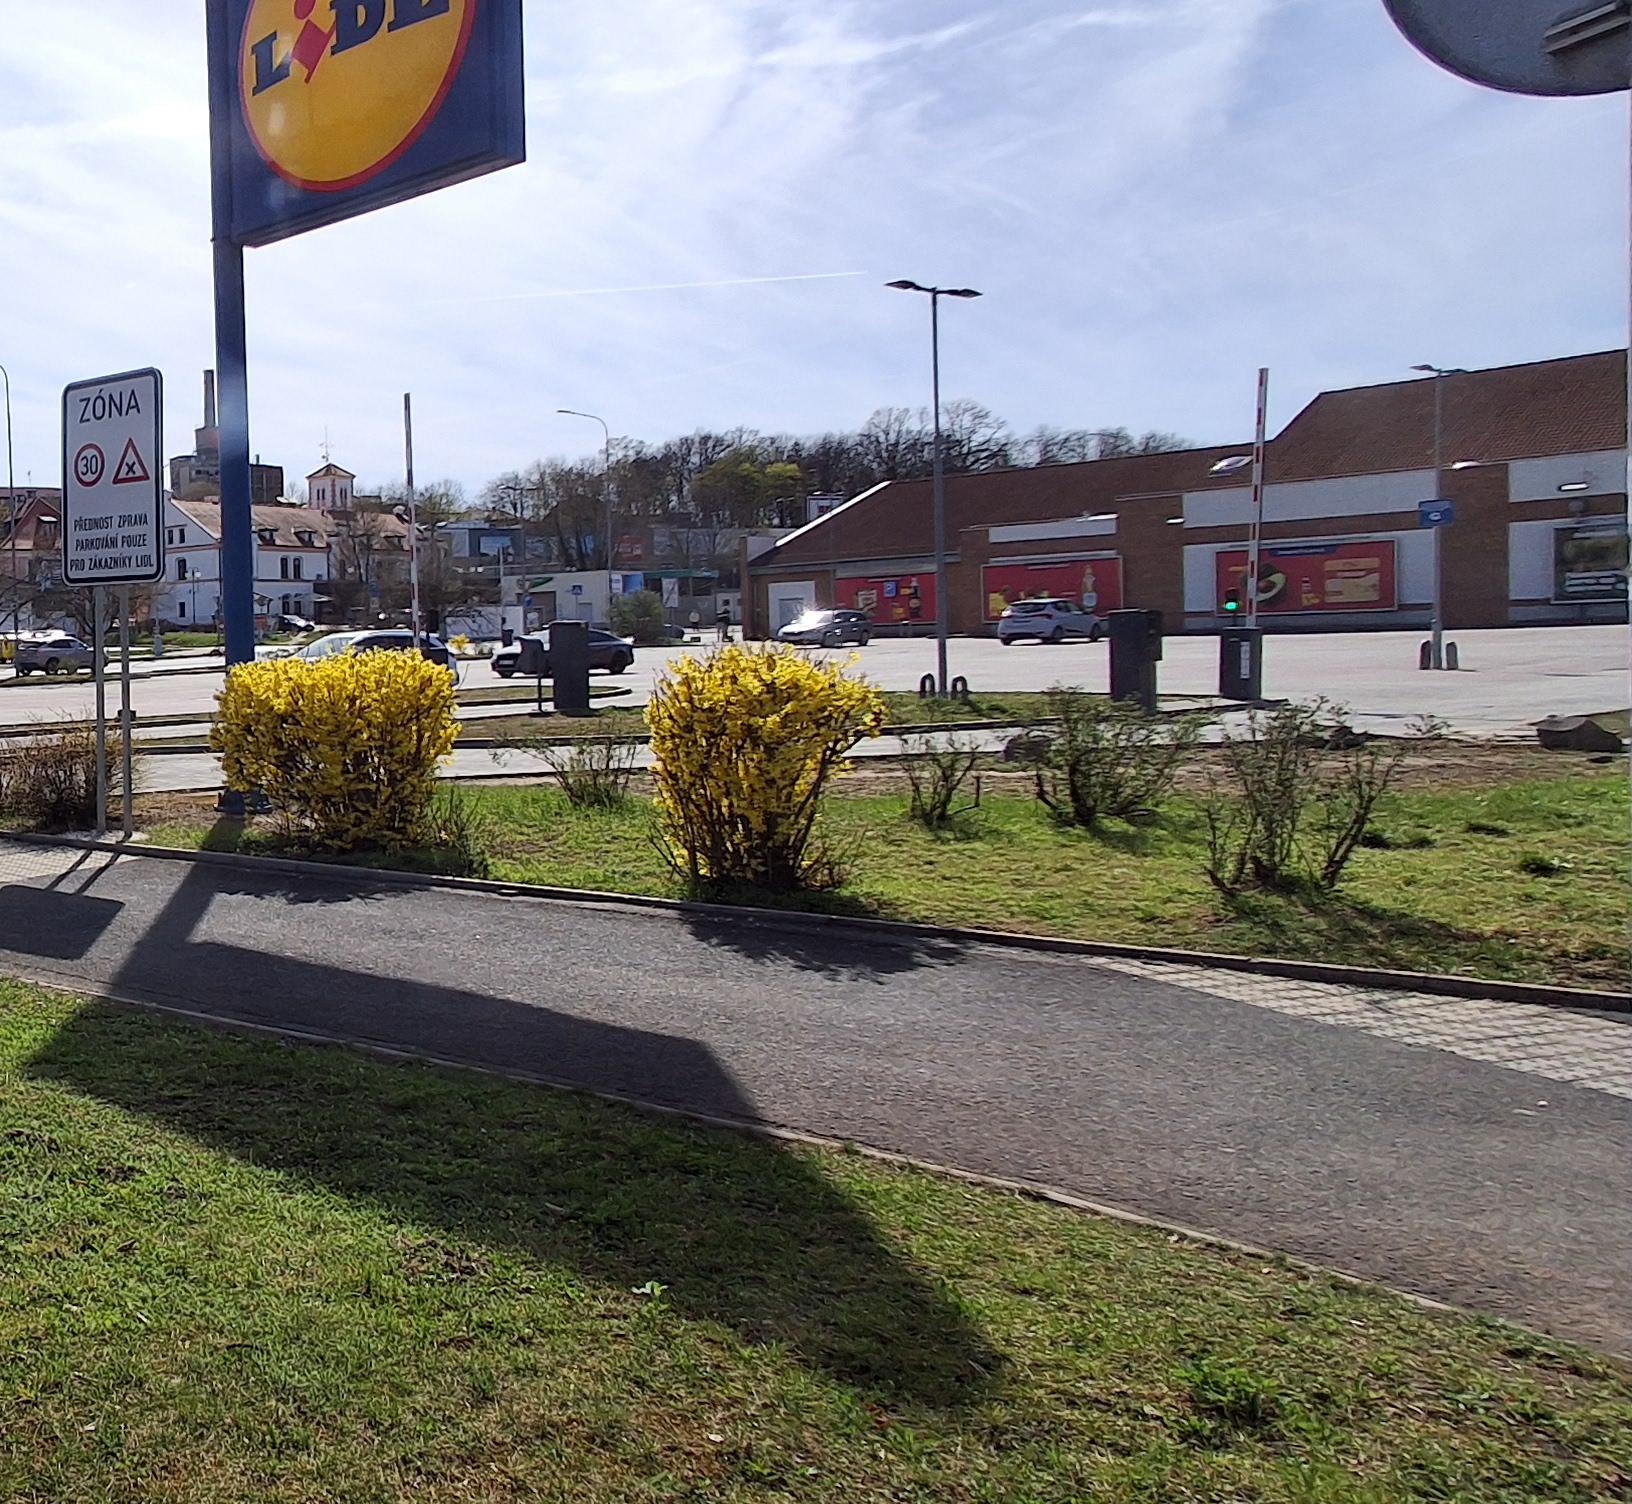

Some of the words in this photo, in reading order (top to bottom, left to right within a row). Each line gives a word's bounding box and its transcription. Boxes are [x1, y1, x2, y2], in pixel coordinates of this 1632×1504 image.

[78, 388, 141, 424] ZÓNA
[79, 454, 99, 476] 30
[73, 515, 114, 532] PŘEDNOST
[117, 513, 148, 529] ZPRAVA
[75, 533, 118, 552] PARKOVÁNÍ
[121, 534, 147, 549] POUZE
[70, 558, 85, 572] PRO
[88, 553, 132, 571] ZÁKAZNÍKY
[135, 554, 154, 568] LIDL
